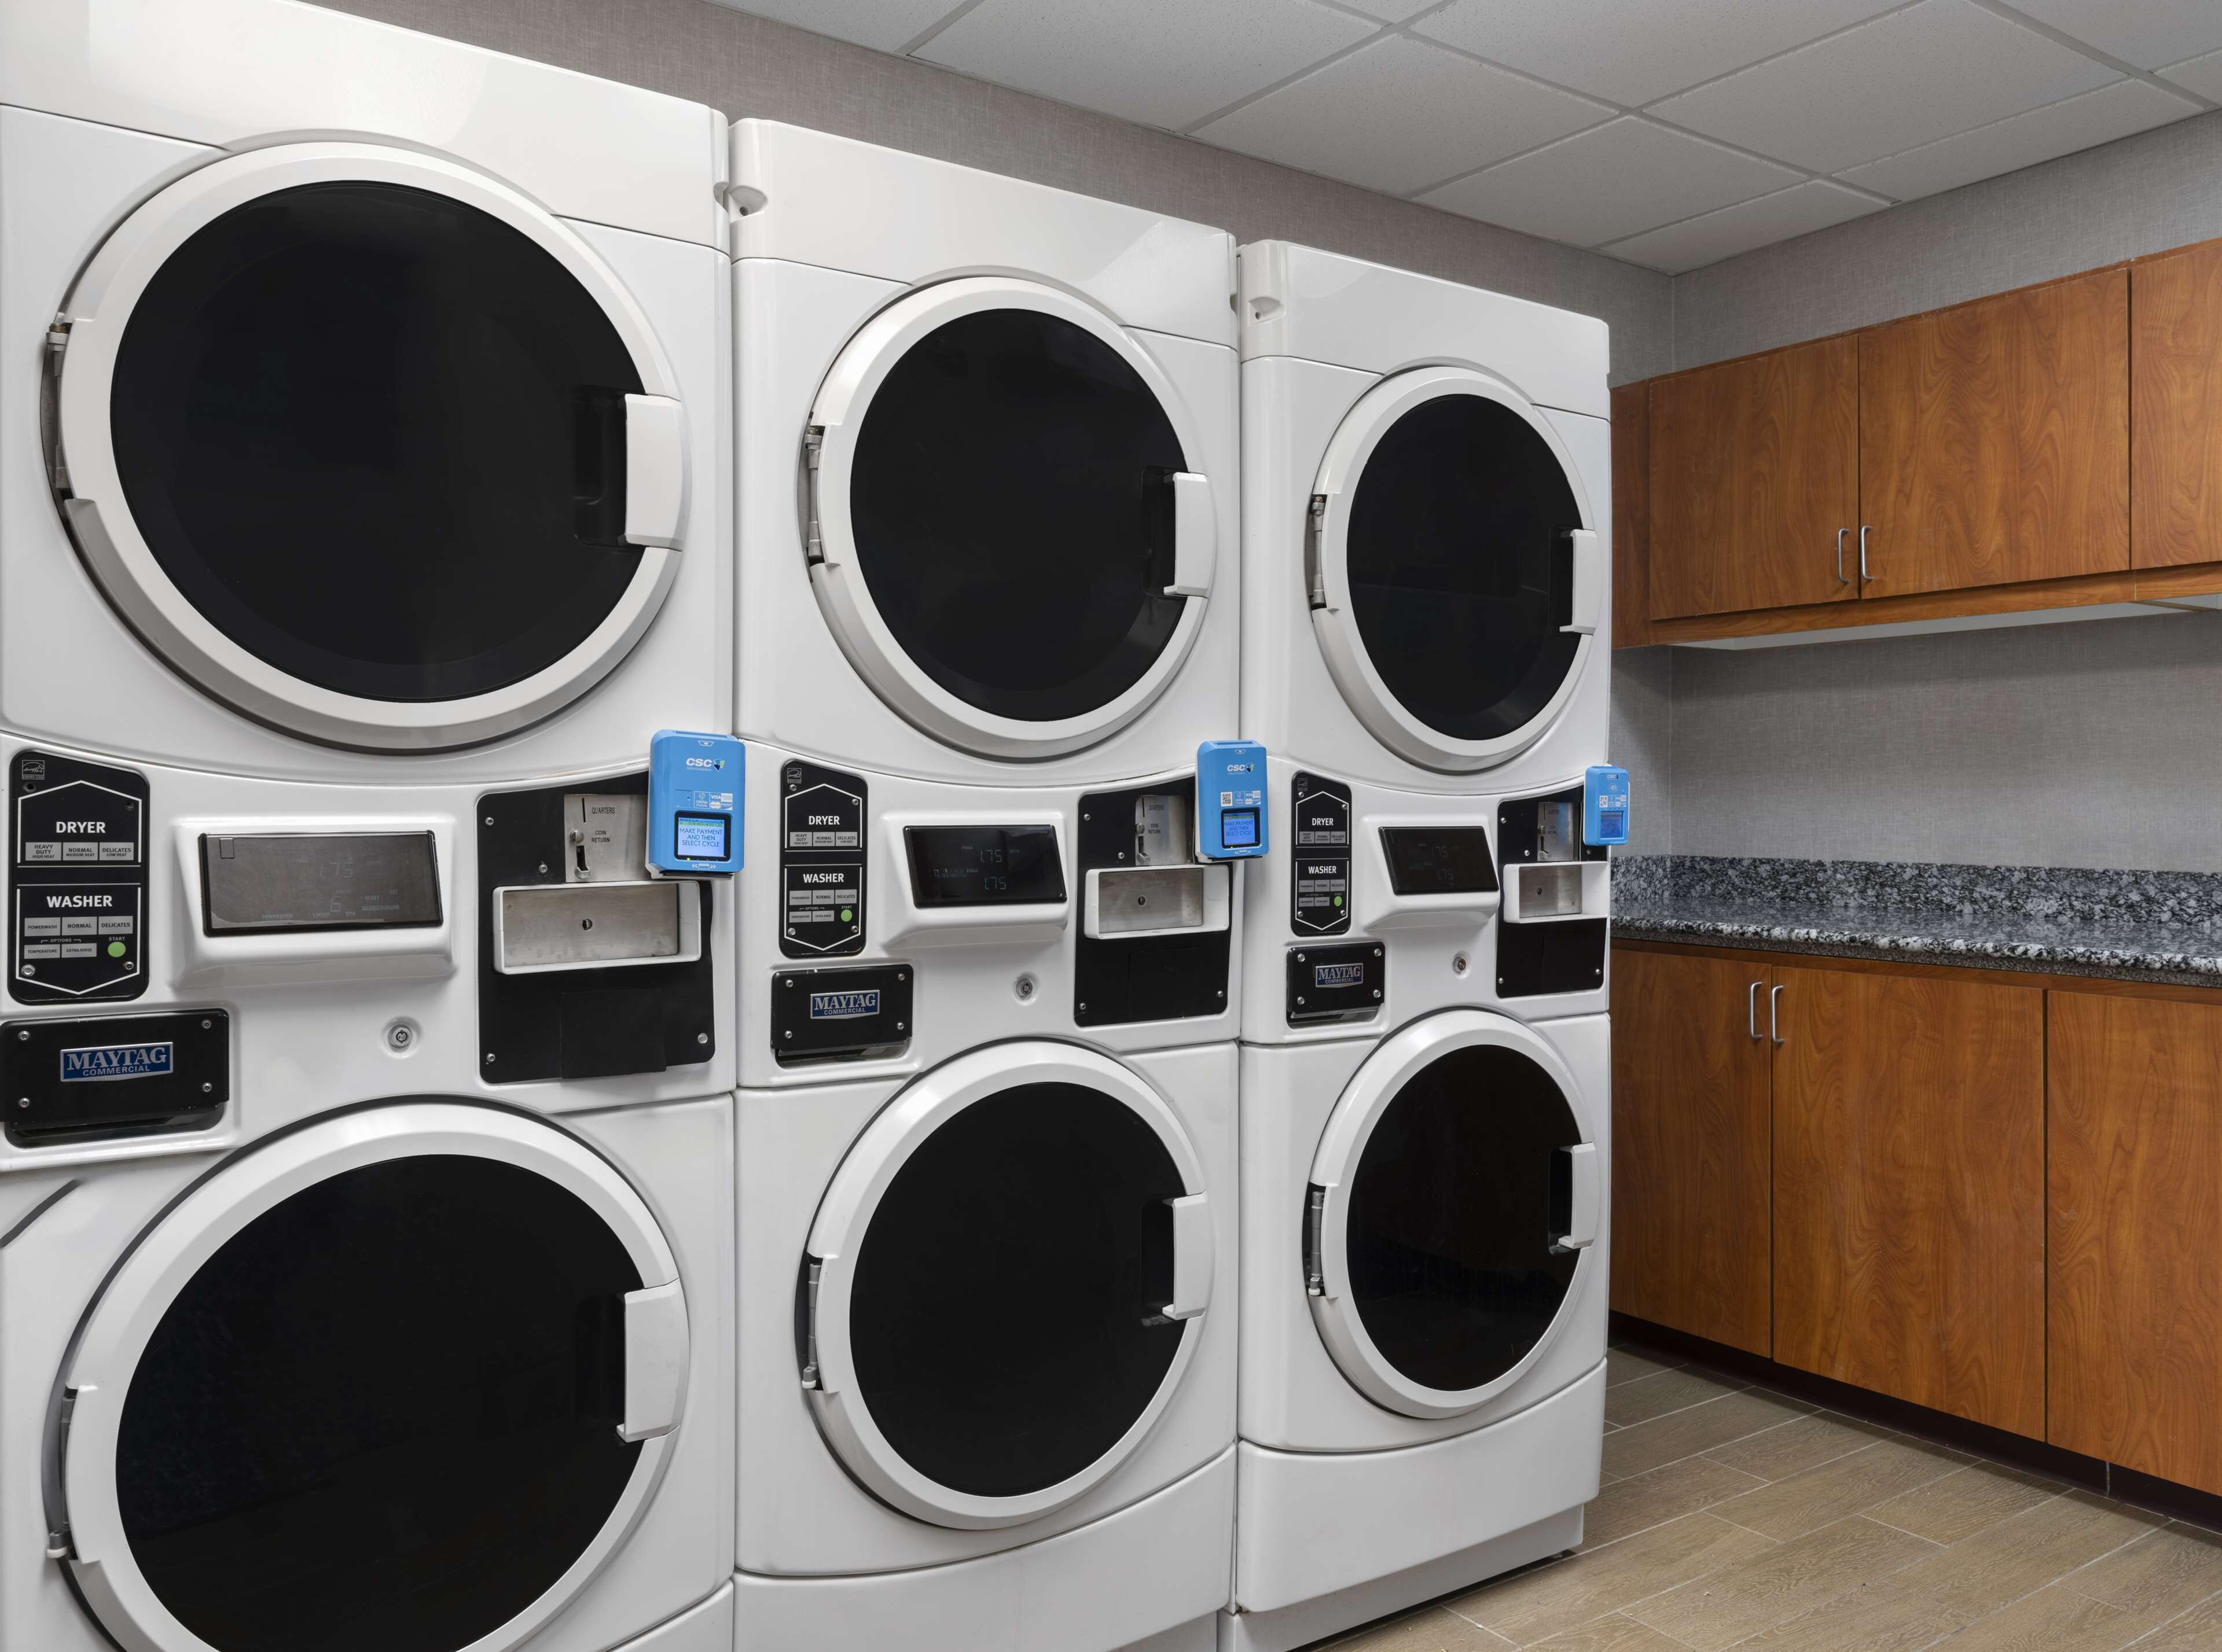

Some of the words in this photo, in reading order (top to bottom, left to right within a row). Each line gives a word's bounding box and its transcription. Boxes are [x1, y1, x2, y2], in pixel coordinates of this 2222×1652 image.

[686, 757, 712, 767] CSC
[809, 816, 840, 825] DRYER
[1312, 818, 1334, 826] DRYER
[56, 822, 106, 833] DRYER
[1308, 866, 1337, 874] WASHER
[803, 873, 844, 883] WASHER
[46, 895, 112, 908] WASHER
[1318, 966, 1360, 980] MAYTAG
[814, 994, 876, 1010] MAYTAG
[67, 1047, 167, 1070] MAYTAG
[83, 1064, 150, 1076] COMMERCIAL
